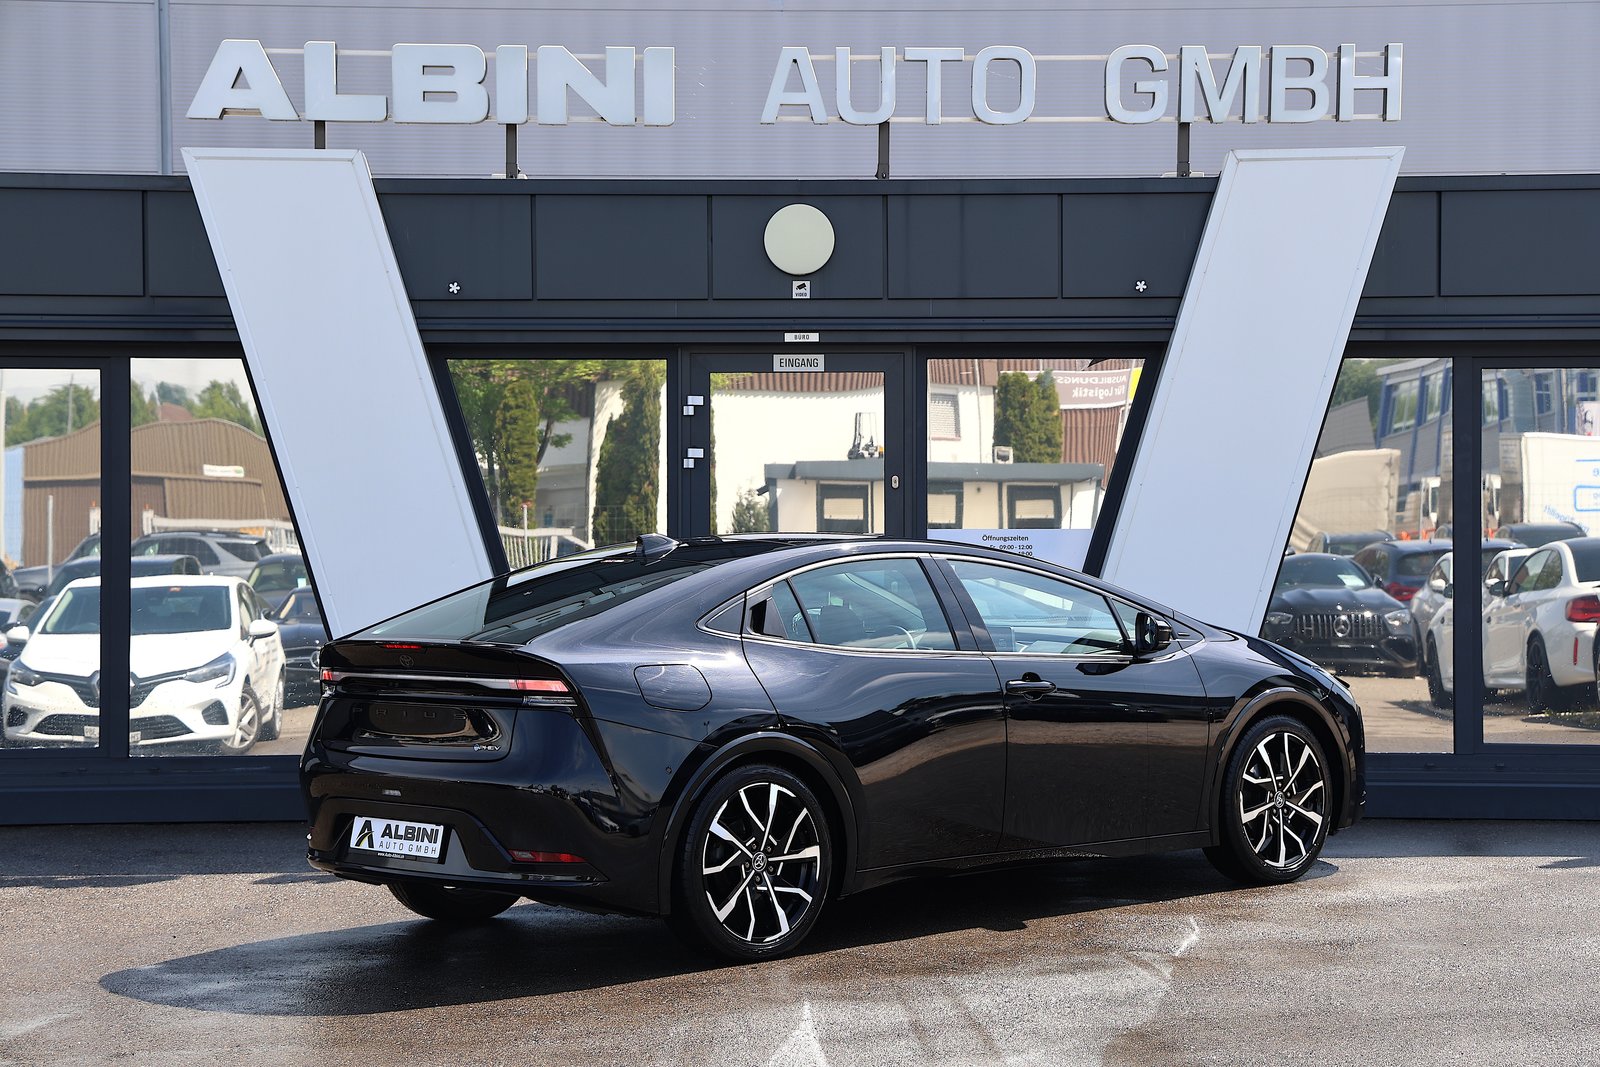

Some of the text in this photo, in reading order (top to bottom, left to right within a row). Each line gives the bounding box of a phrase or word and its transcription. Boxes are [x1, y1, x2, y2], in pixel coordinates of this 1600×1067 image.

[186, 39, 1403, 126] ALBINI AUTO GMBH
[779, 358, 819, 368] EINGANG
[380, 823, 440, 844] ALBINI
[379, 840, 437, 855] AUTO GMBH
